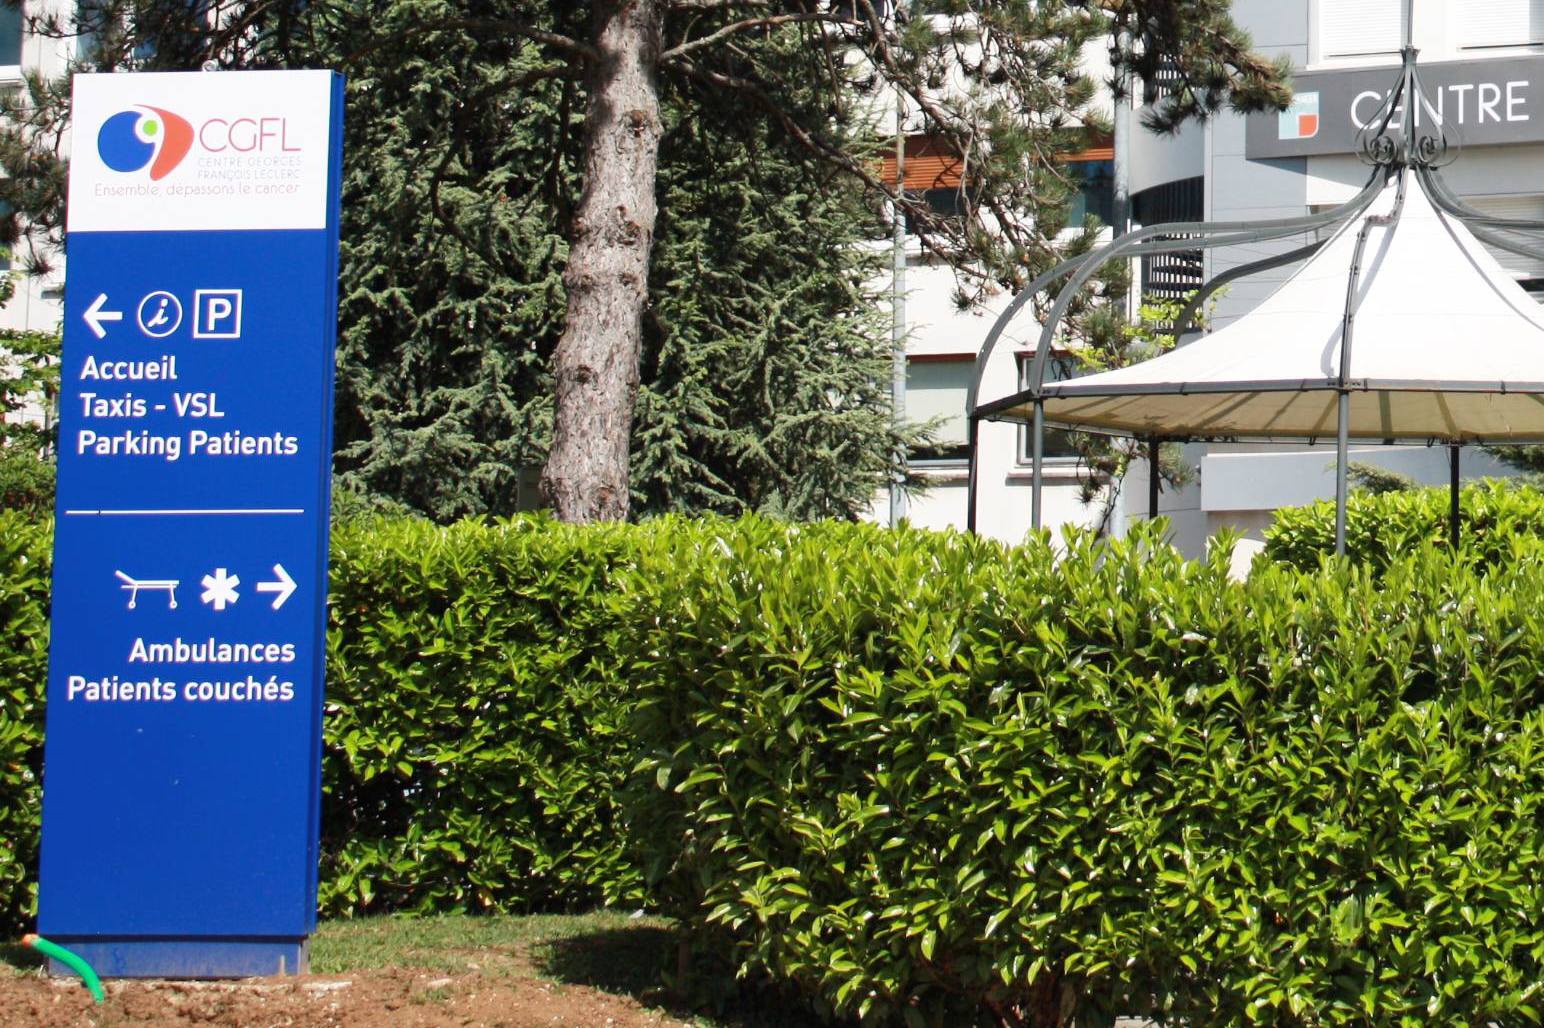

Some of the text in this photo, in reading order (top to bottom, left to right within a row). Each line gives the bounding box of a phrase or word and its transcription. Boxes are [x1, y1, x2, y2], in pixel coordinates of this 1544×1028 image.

[1350, 80, 1530, 130] CENTRE
[199, 117, 301, 152] CGFL
[198, 155, 302, 168] CENTRE GEORGES
[94, 182, 300, 198] Ensemble, dépassons le cancer
[80, 355, 178, 380] Accueil
[80, 392, 147, 418] Taxis
[173, 392, 225, 418] VSL
[77, 430, 298, 461] Parking Patients
[129, 637, 296, 663] Ambulances
[67, 675, 295, 701] Patients couchés
